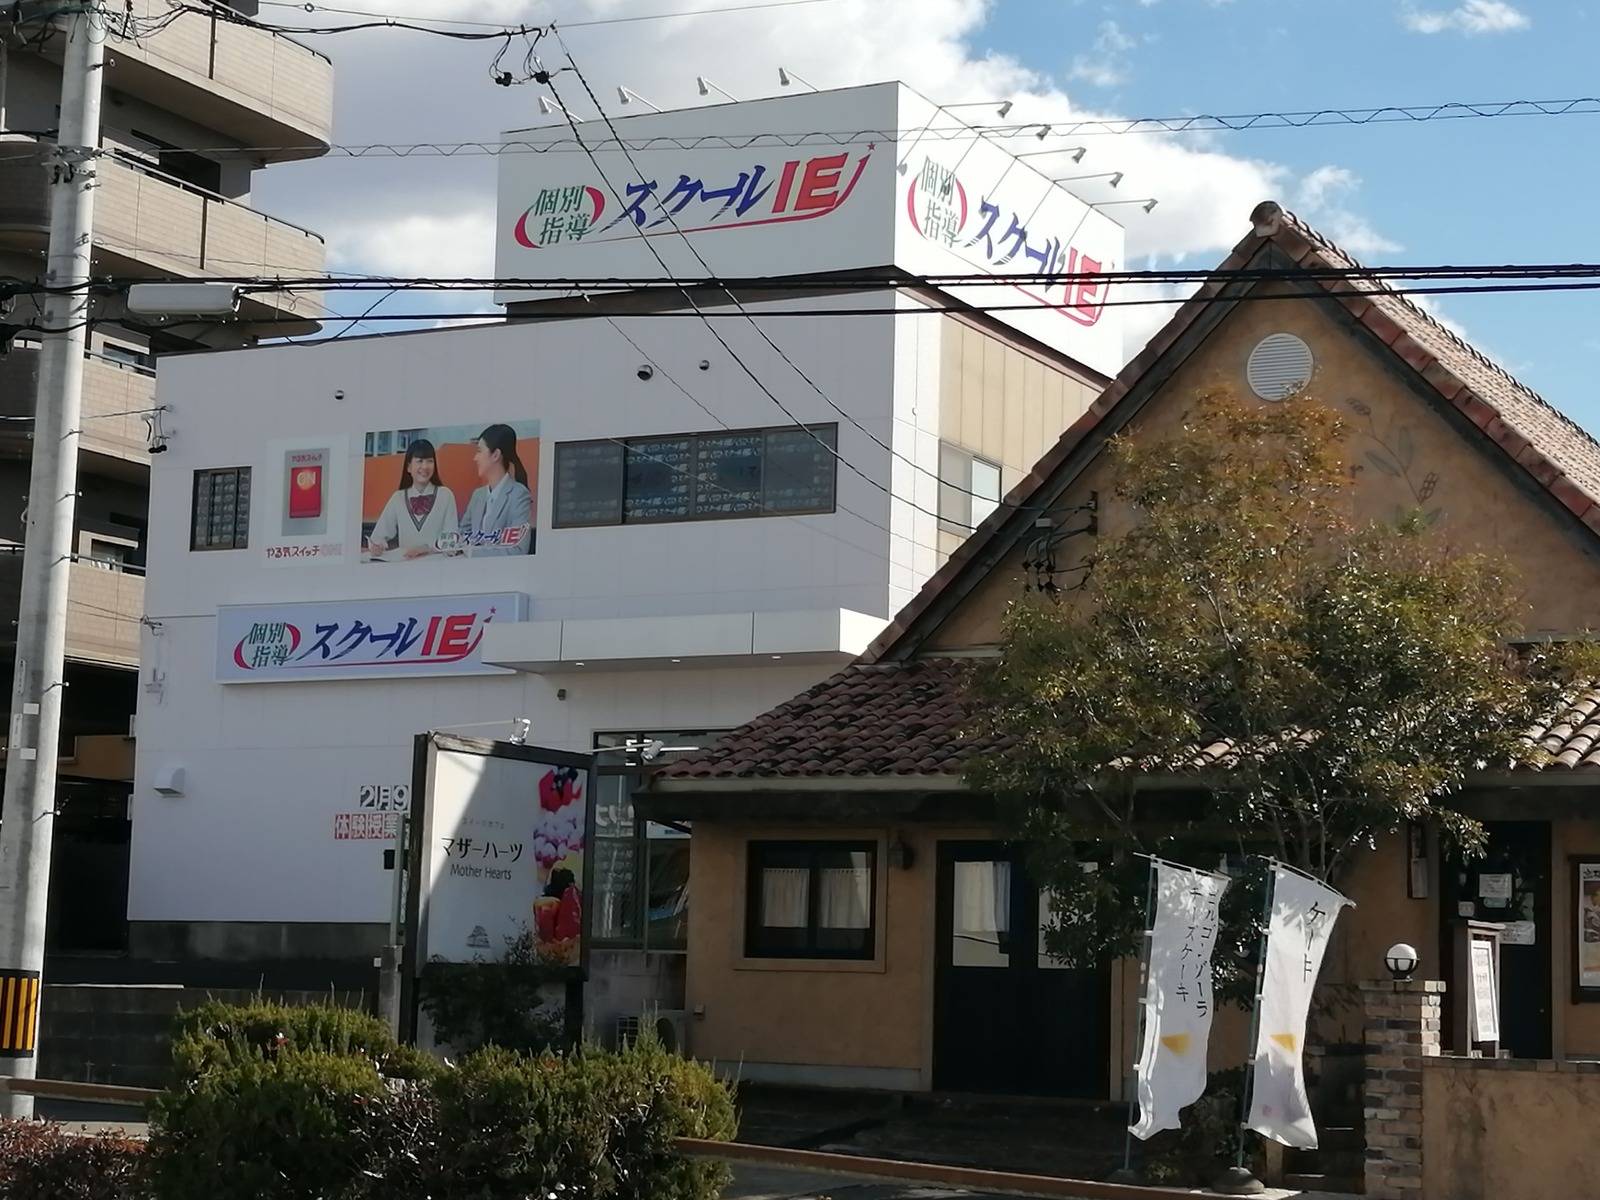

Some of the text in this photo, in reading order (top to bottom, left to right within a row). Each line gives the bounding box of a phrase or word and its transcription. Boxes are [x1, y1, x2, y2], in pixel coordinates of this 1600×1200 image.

[534, 184, 586, 216] 個別
[600, 152, 850, 232] スクールIE
[538, 212, 594, 246] 指導
[266, 544, 320, 559] やる気スイッチ
[248, 621, 287, 645] 個別
[296, 612, 478, 662] スクールIE
[251, 644, 293, 668] 指導
[335, 812, 400, 840] 体験授業
[441, 837, 523, 863] マザーハーツ
[450, 863, 512, 881] Mother Hearts
